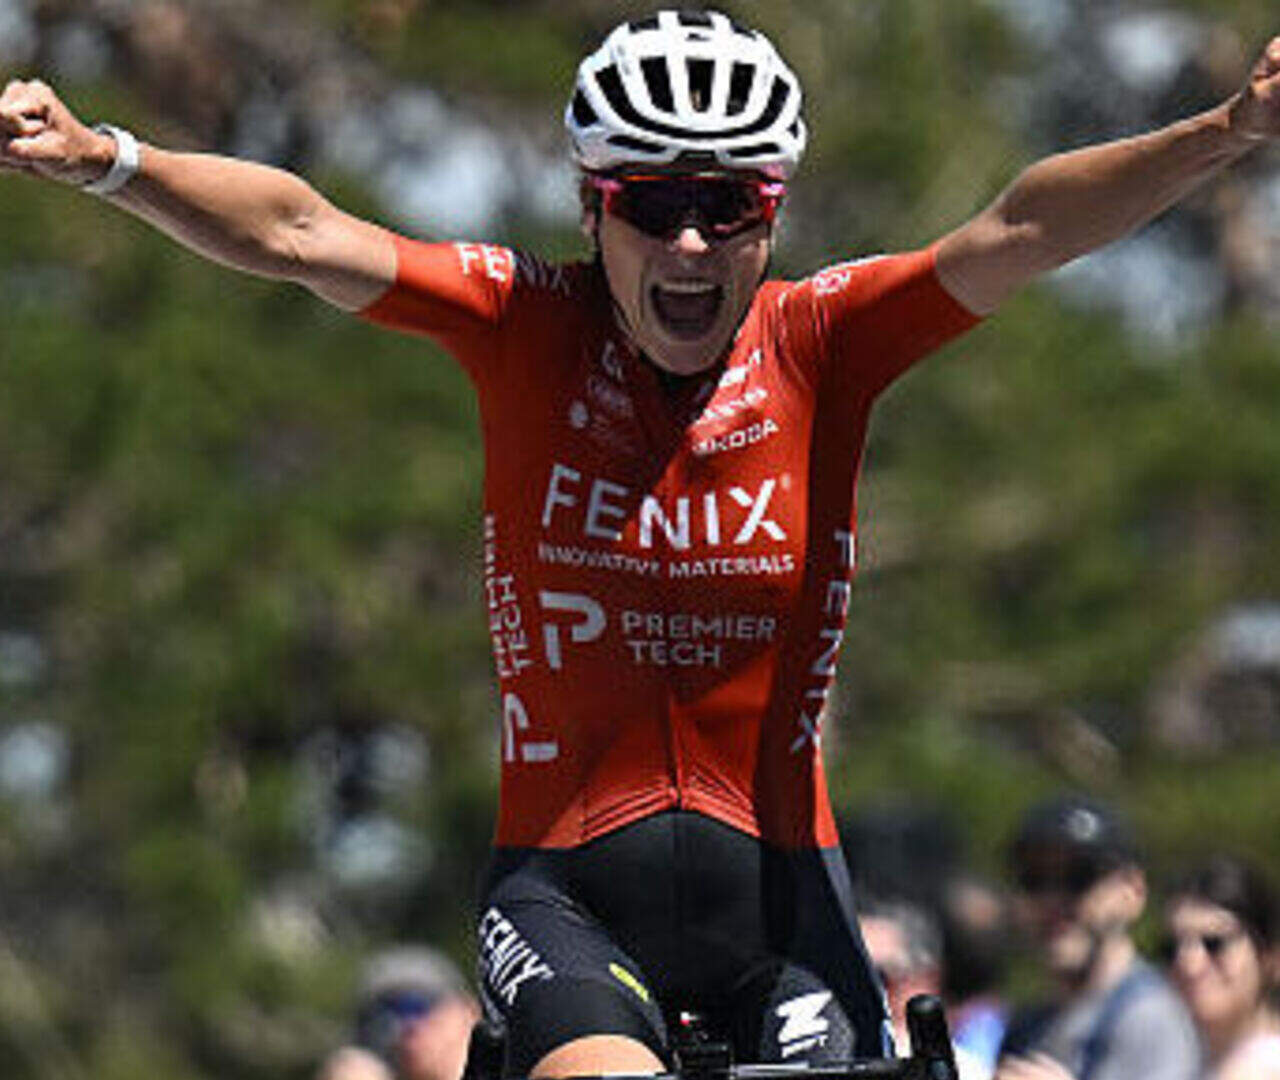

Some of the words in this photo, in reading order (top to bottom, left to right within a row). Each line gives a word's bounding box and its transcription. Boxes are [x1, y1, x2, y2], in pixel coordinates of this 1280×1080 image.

[541, 463, 788, 550] FENIX
[537, 541, 661, 578] INNOVATIVE
[669, 553, 796, 578] MATERIALS
[622, 609, 777, 642] PREMIER
[627, 640, 721, 667] TECH
[790, 518, 856, 753] FENIX
[478, 905, 555, 1006] FENIX
